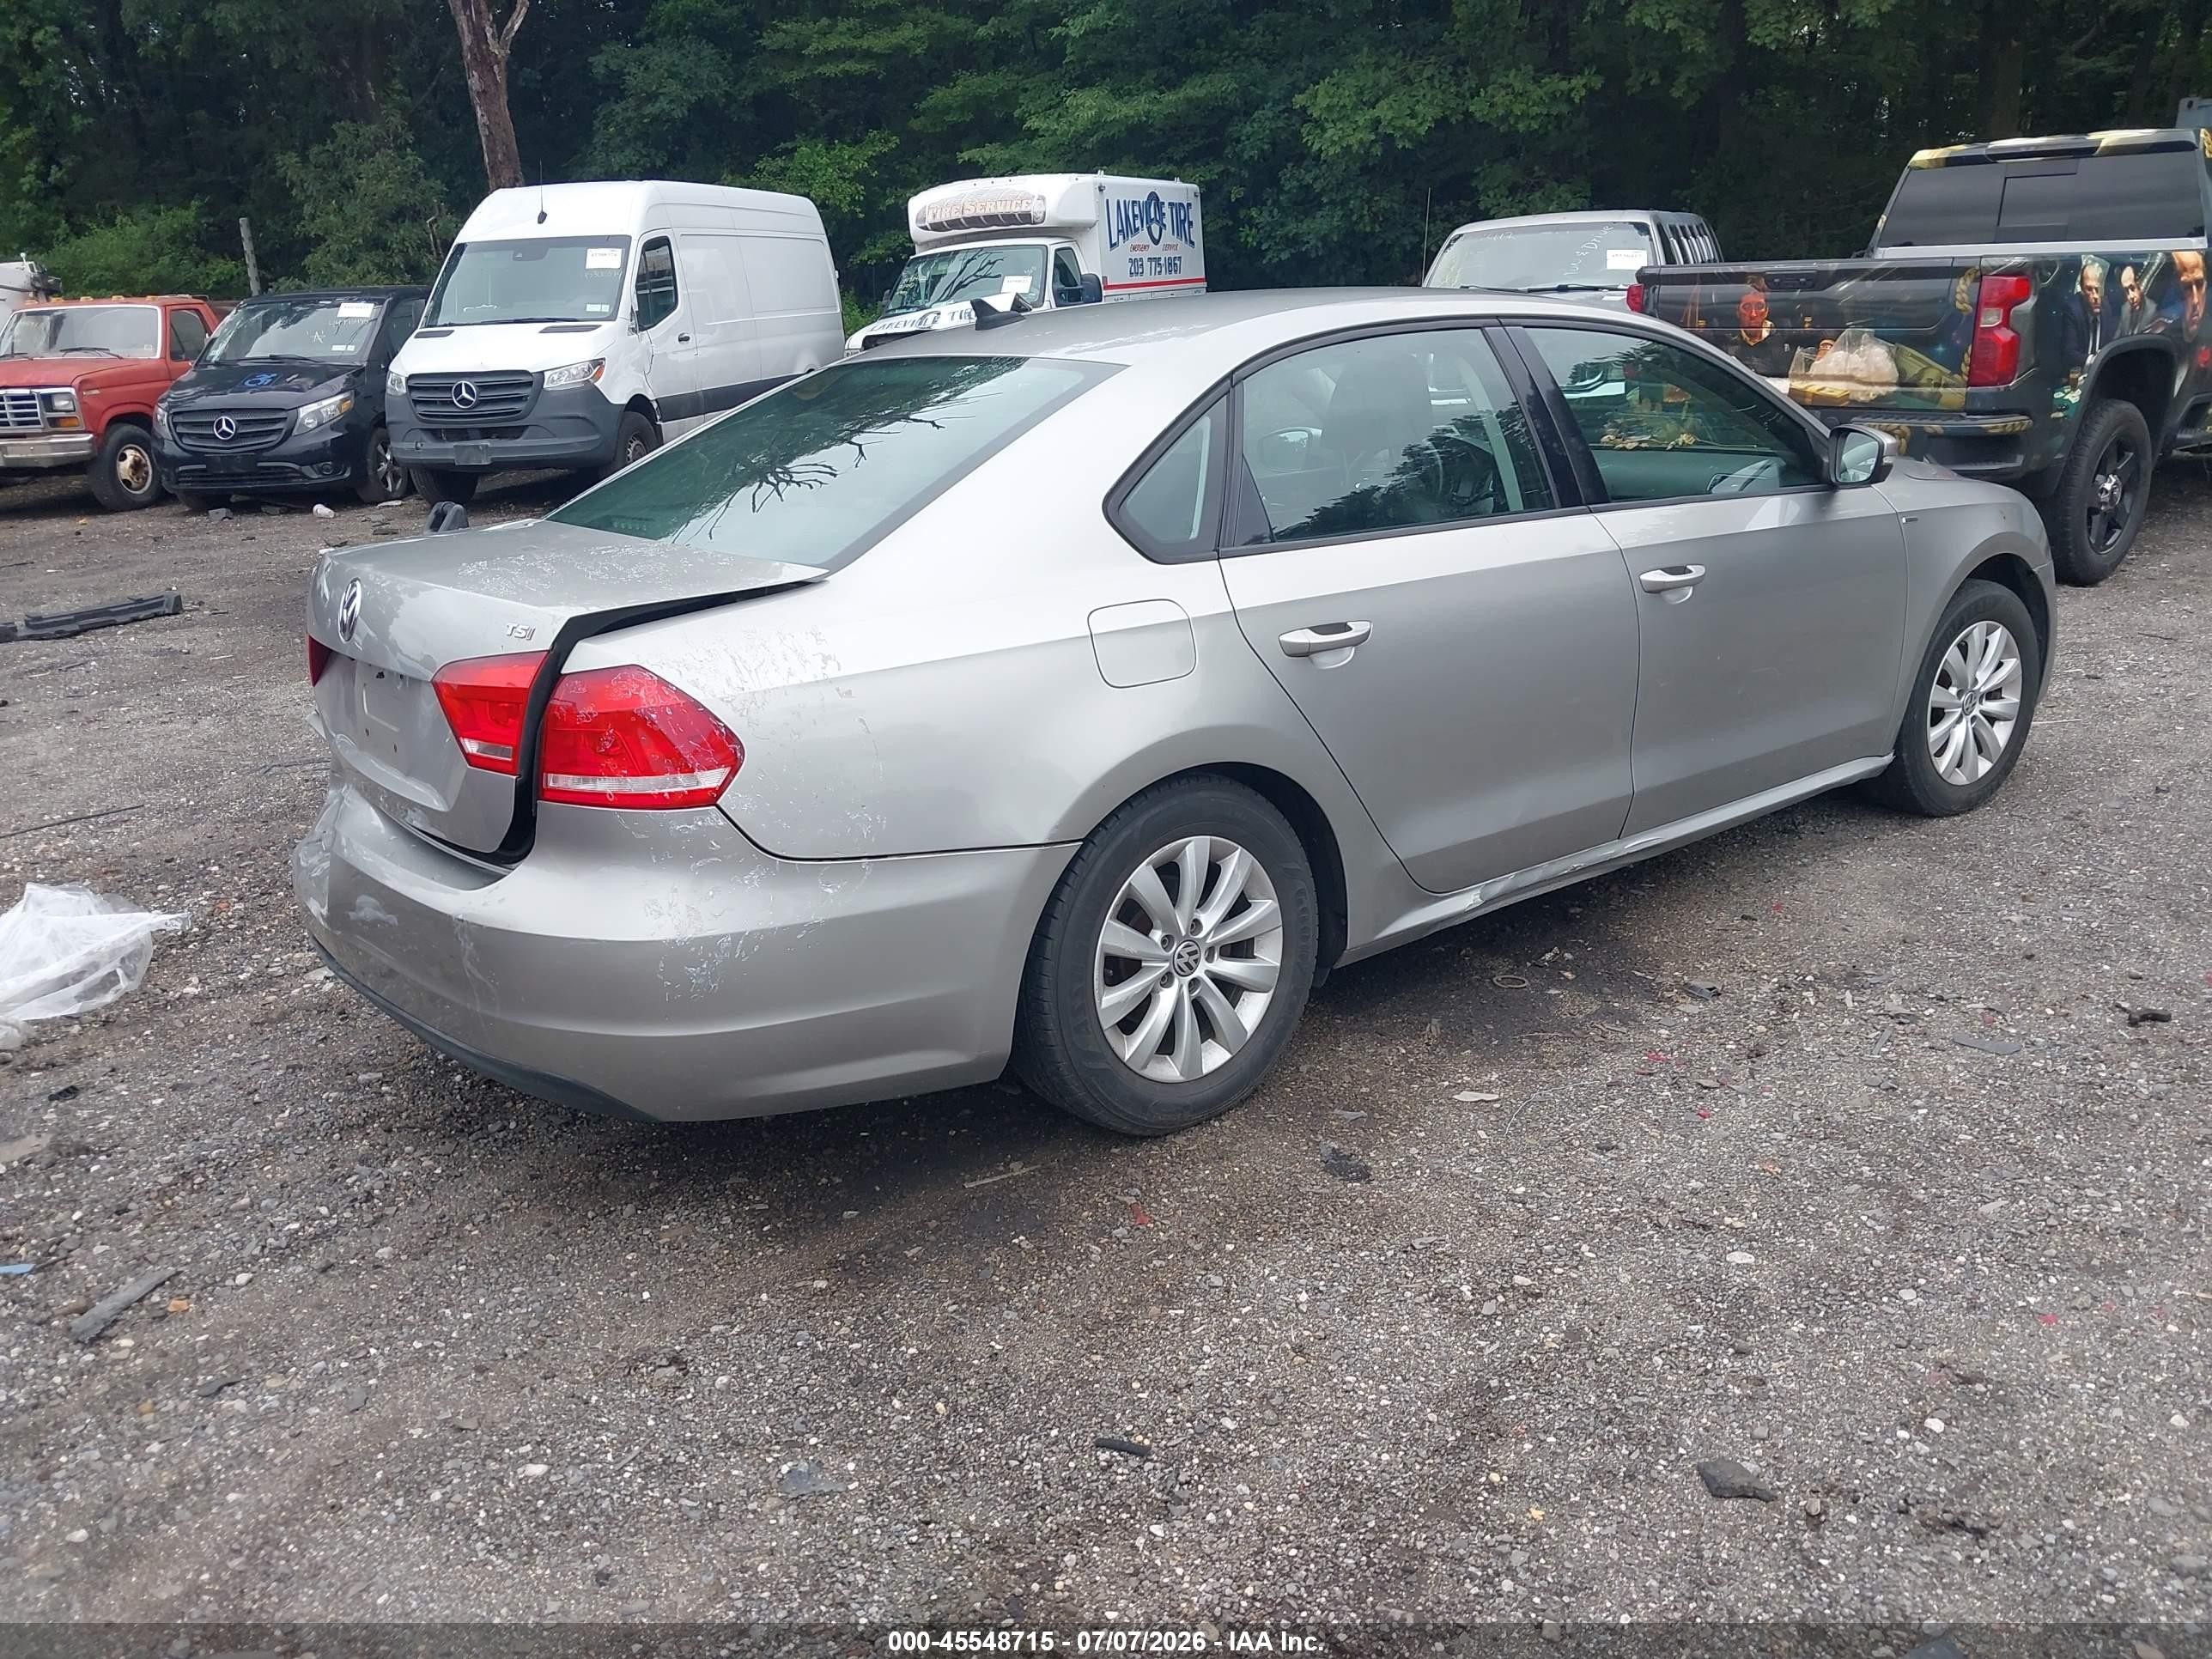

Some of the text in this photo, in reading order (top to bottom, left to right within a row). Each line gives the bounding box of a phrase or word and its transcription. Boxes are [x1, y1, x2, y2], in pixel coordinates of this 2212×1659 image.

[963, 199, 1031, 215] SERVICE
[1106, 198, 1195, 252] LAKEVILLE TIRE
[1128, 258, 1145, 277] 203
